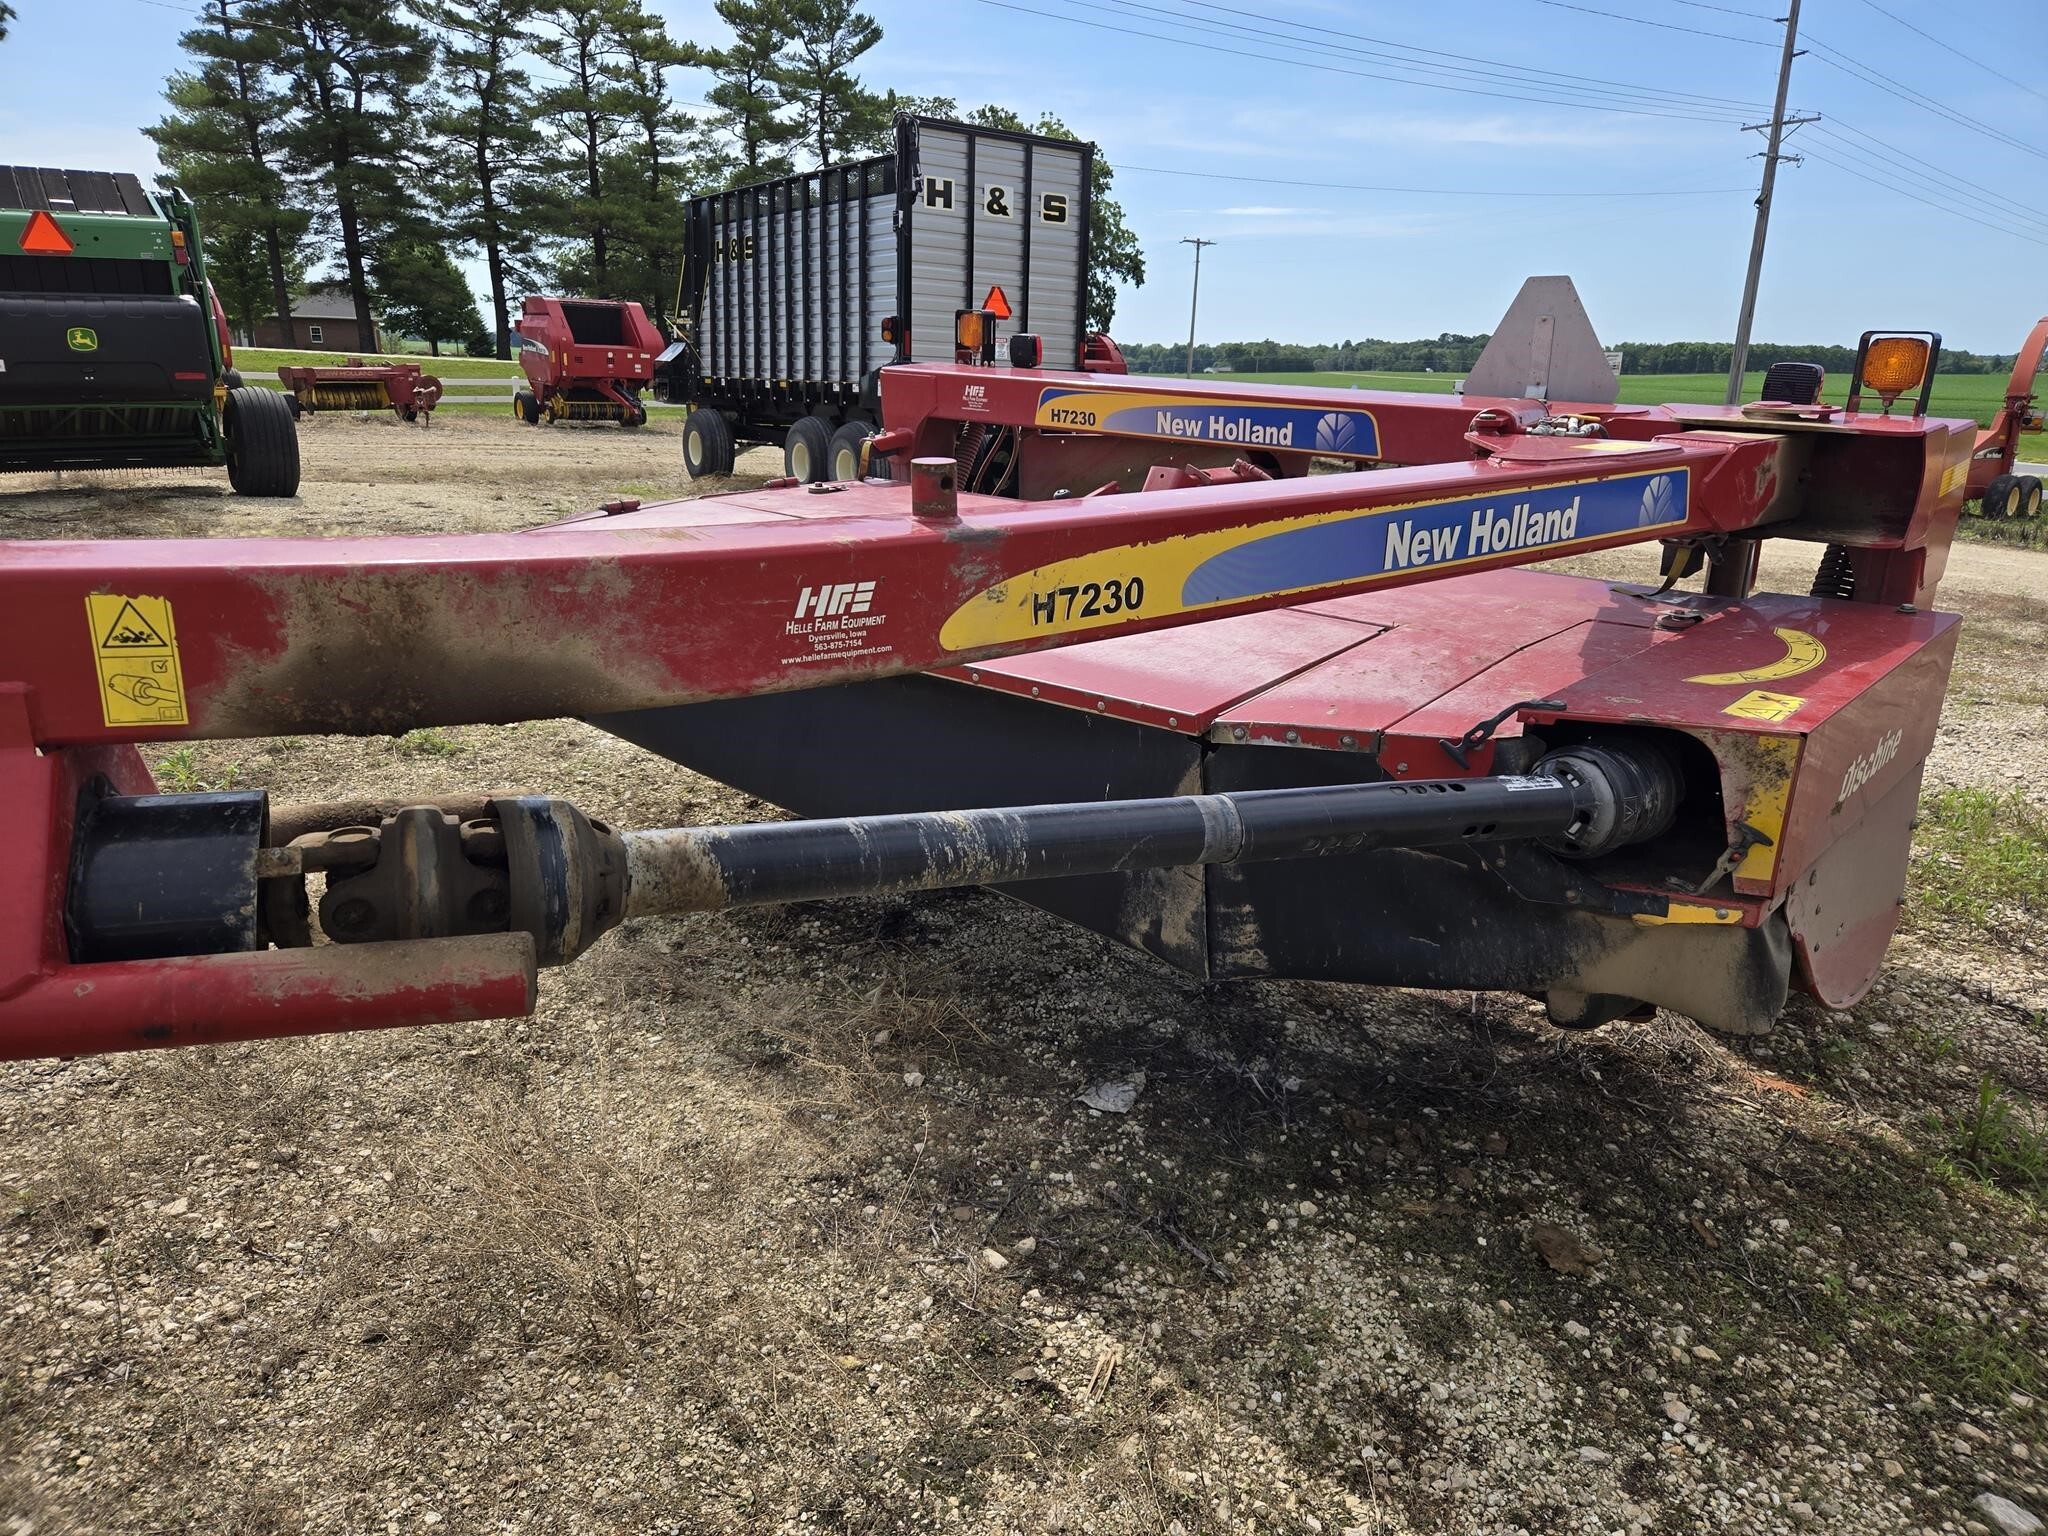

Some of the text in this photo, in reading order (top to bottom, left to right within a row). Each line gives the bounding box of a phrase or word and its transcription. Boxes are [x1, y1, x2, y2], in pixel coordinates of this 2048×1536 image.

[925, 177, 1067, 223] H & S
[1050, 408, 1097, 427] H7230
[1155, 410, 1293, 447] New Holland
[1383, 495, 1581, 571] New Holland
[1032, 576, 1144, 626] H7230
[808, 629, 867, 643] Dyersville, Iowa
[814, 638, 863, 652] 563-875-7154
[781, 645, 893, 665] www.hellefarmequipment.com
